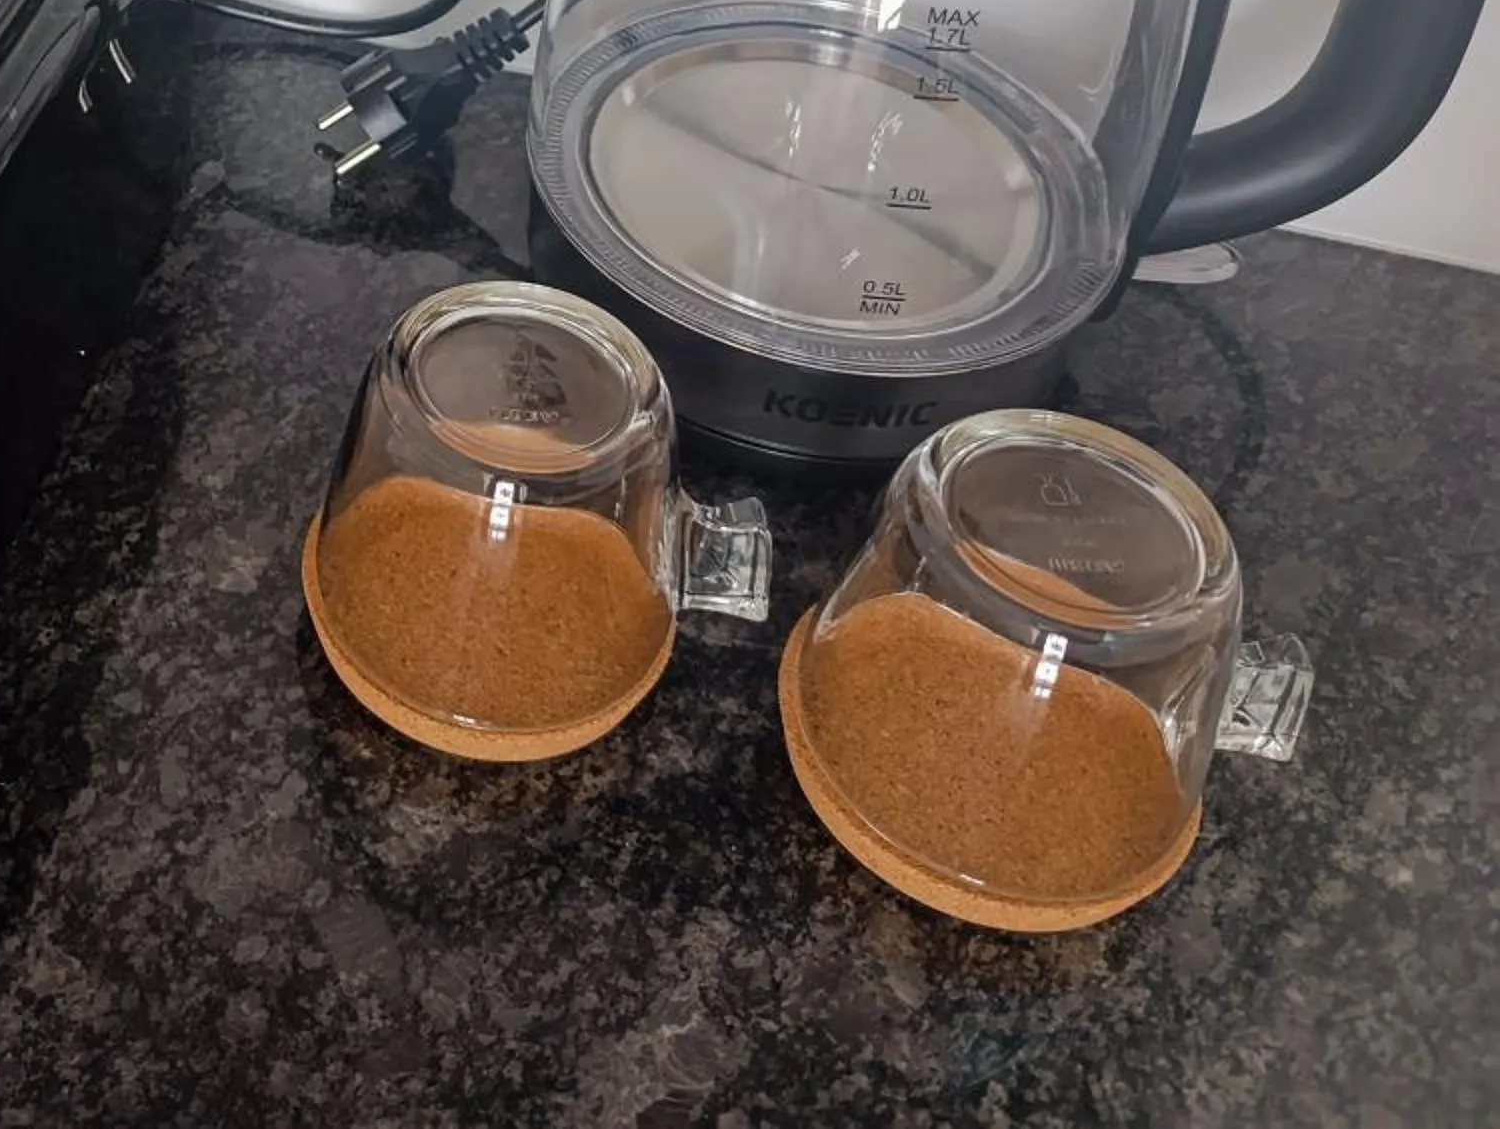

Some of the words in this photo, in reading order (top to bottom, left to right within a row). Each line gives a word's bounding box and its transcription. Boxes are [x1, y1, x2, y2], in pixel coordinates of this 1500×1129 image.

[927, 6, 980, 28] MAX
[888, 186, 931, 204] 1.0L
[859, 299, 902, 317] MIN
[762, 388, 940, 428] KOENIC
